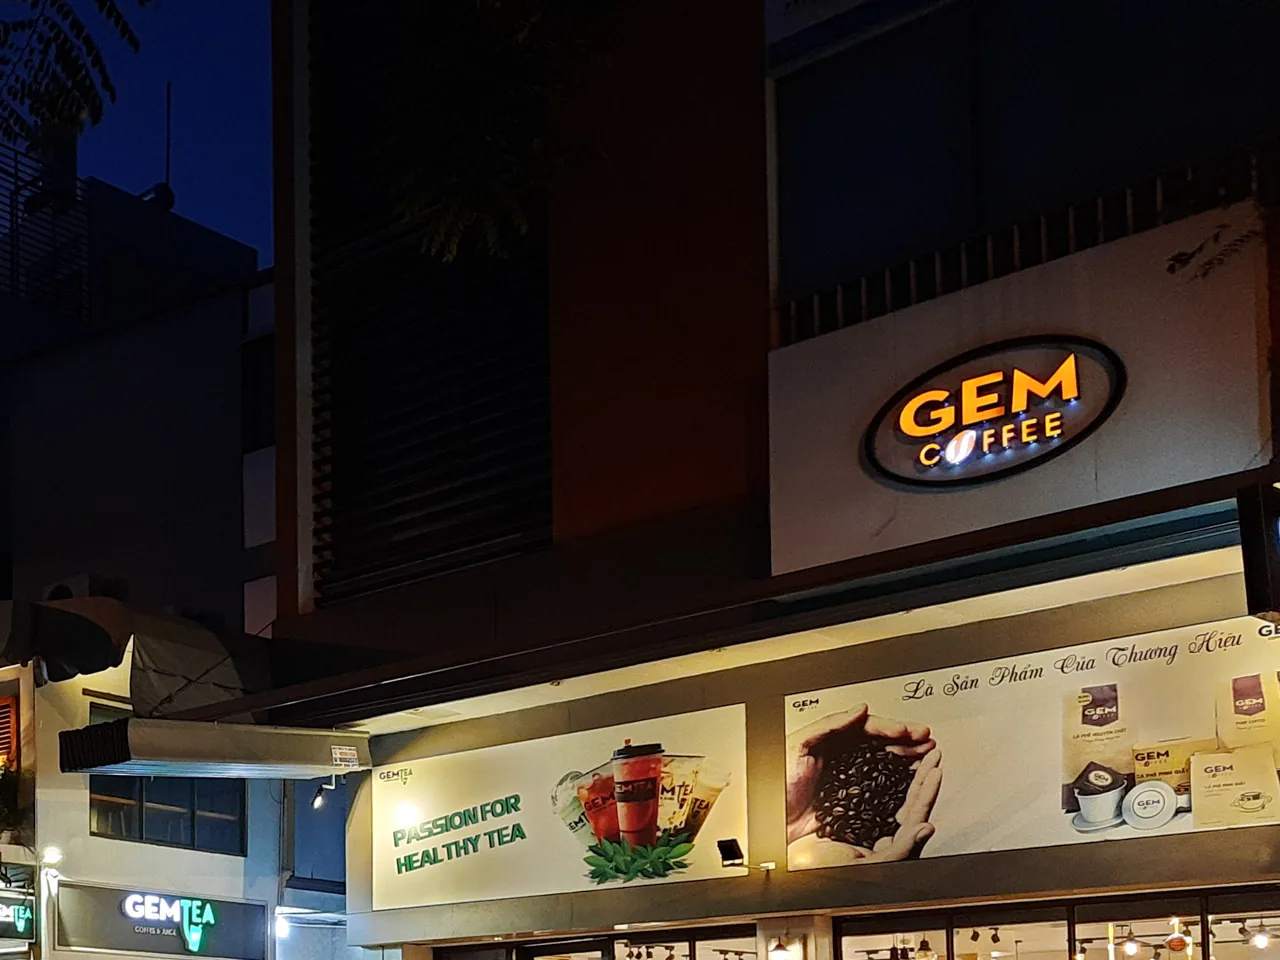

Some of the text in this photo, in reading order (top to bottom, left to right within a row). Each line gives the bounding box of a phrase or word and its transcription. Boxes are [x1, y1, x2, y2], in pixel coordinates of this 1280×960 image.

[898, 353, 1079, 437] GEM
[919, 412, 1062, 467] COFFEE
[901, 629, 1243, 701] Là Sản Phẩm Của Thương Hiệu
[792, 698, 820, 708] GEM
[1084, 705, 1117, 716] GEM
[1134, 750, 1170, 762] GEM
[1203, 764, 1234, 774] GEM
[379, 768, 413, 783] GEMTEA
[1137, 799, 1161, 807] GEM
[393, 794, 521, 848] PASSION FOR
[396, 822, 527, 874] HEALTHY TEA
[123, 893, 215, 945] GEMTEA
